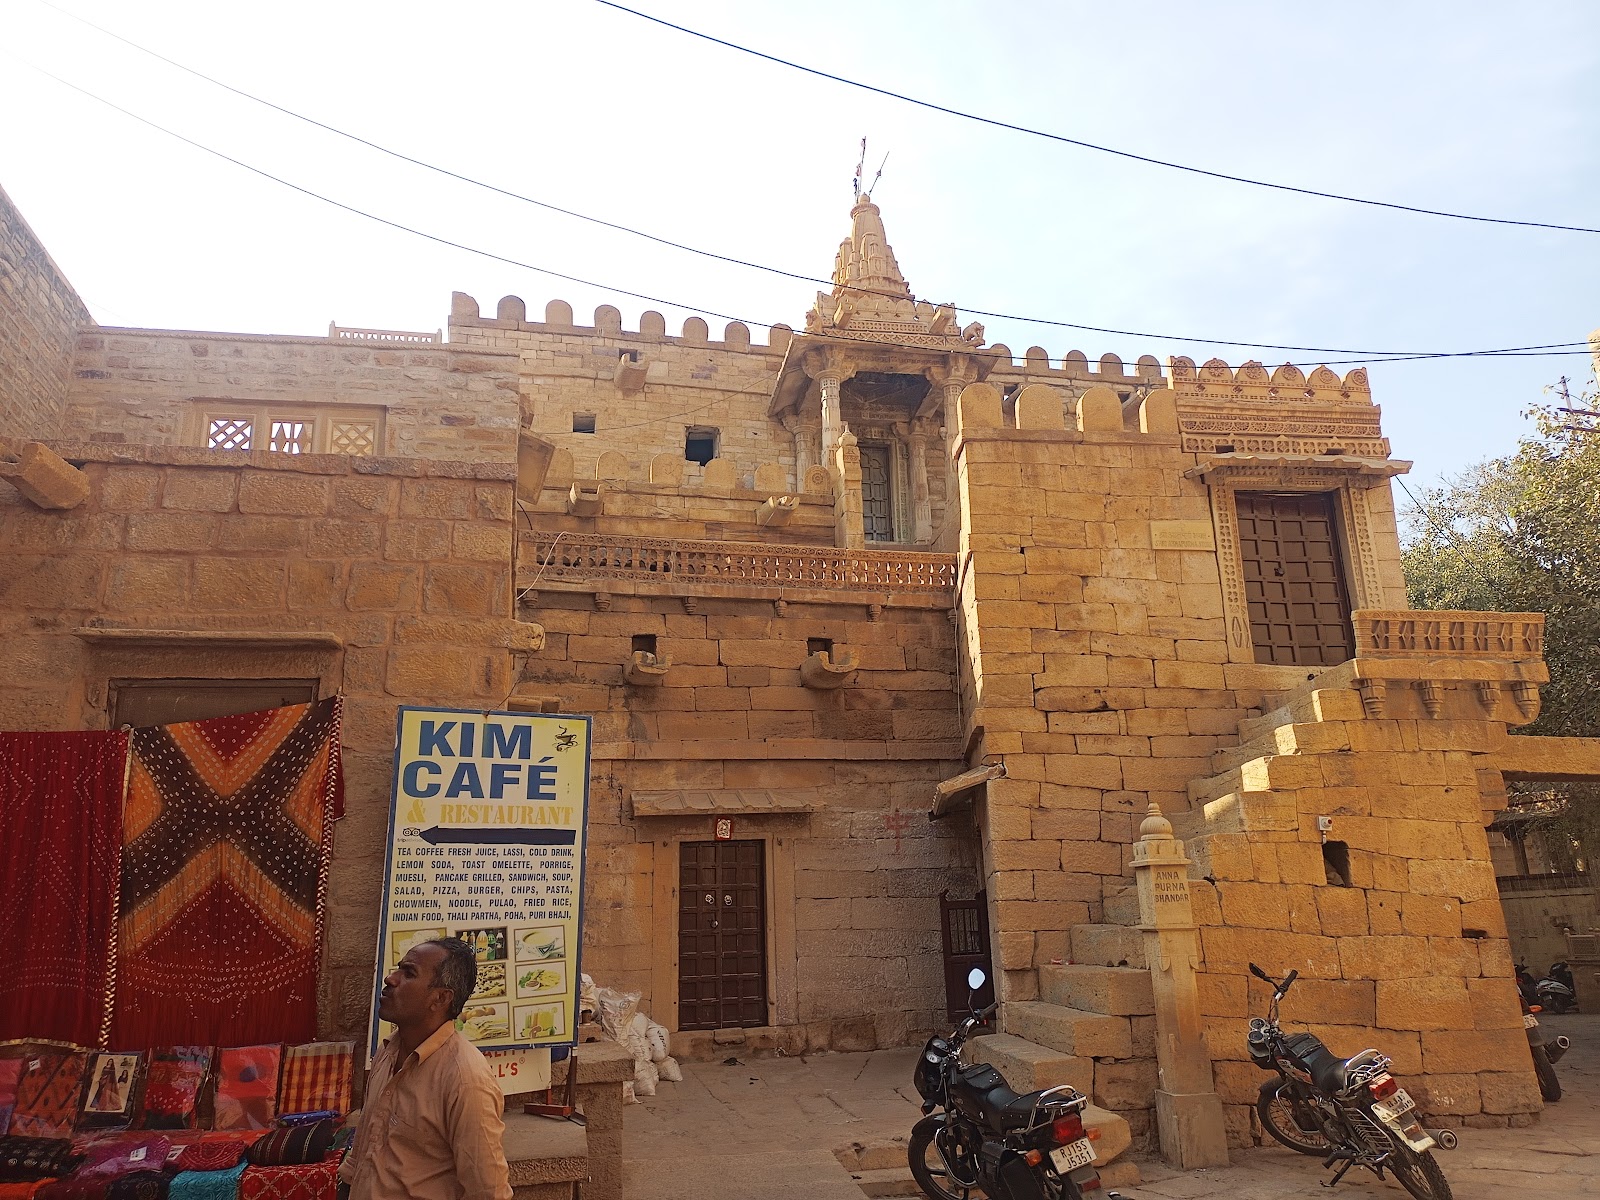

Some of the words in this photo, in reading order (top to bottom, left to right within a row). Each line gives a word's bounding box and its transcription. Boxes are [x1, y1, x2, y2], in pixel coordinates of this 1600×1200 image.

[418, 720, 532, 760] KIM
[402, 757, 558, 801] CAFÉ
[406, 799, 427, 824] &
[440, 804, 574, 825] RESTAURANT
[397, 847, 412, 856] TEA
[415, 847, 444, 856] COFFEE
[448, 847, 472, 856] FRESH
[475, 847, 499, 858] JUICE,
[503, 848, 525, 858] LASSI,
[529, 848, 547, 857] COLD
[551, 848, 574, 858] DRINK,
[396, 860, 424, 869] LEMON
[431, 860, 455, 871] SODA,
[461, 860, 486, 869] TOAST
[492, 860, 533, 870] OMELETTE,
[540, 860, 574, 870] PORRIGE,
[395, 873, 427, 883] MUESLI,
[435, 873, 469, 882] PANCAKE
[472, 873, 505, 883] GRILLED,
[508, 873, 549, 883] SANDWICH,
[552, 873, 573, 883] SOUP,
[1156, 871, 1180, 880] ANNA
[394, 886, 425, 897] SALAD,
[432, 886, 460, 896] PIZZA,
[468, 886, 504, 896] BURGER,
[511, 886, 539, 896] CHIPS,
[545, 885, 573, 895] PASTA,
[1154, 882, 1186, 892] PURNA
[393, 899, 441, 910] CHOWMEIN,
[448, 899, 482, 910] NOODLE,
[489, 898, 517, 908] PULAO,
[523, 898, 546, 907] FRIED
[552, 898, 572, 908] RICE,
[392, 912, 419, 922] INDIAN
[421, 912, 444, 923] FOOD,
[447, 912, 468, 921] THALI
[470, 911, 502, 922] PARTHA,
[504, 911, 526, 921] POHA,
[528, 911, 546, 920] PURI
[548, 910, 572, 921] BHAJI,
[491, 1062, 518, 1078] L'S
[1059, 1140, 1088, 1159] RJ15S
[1067, 1150, 1093, 1169] J5351
